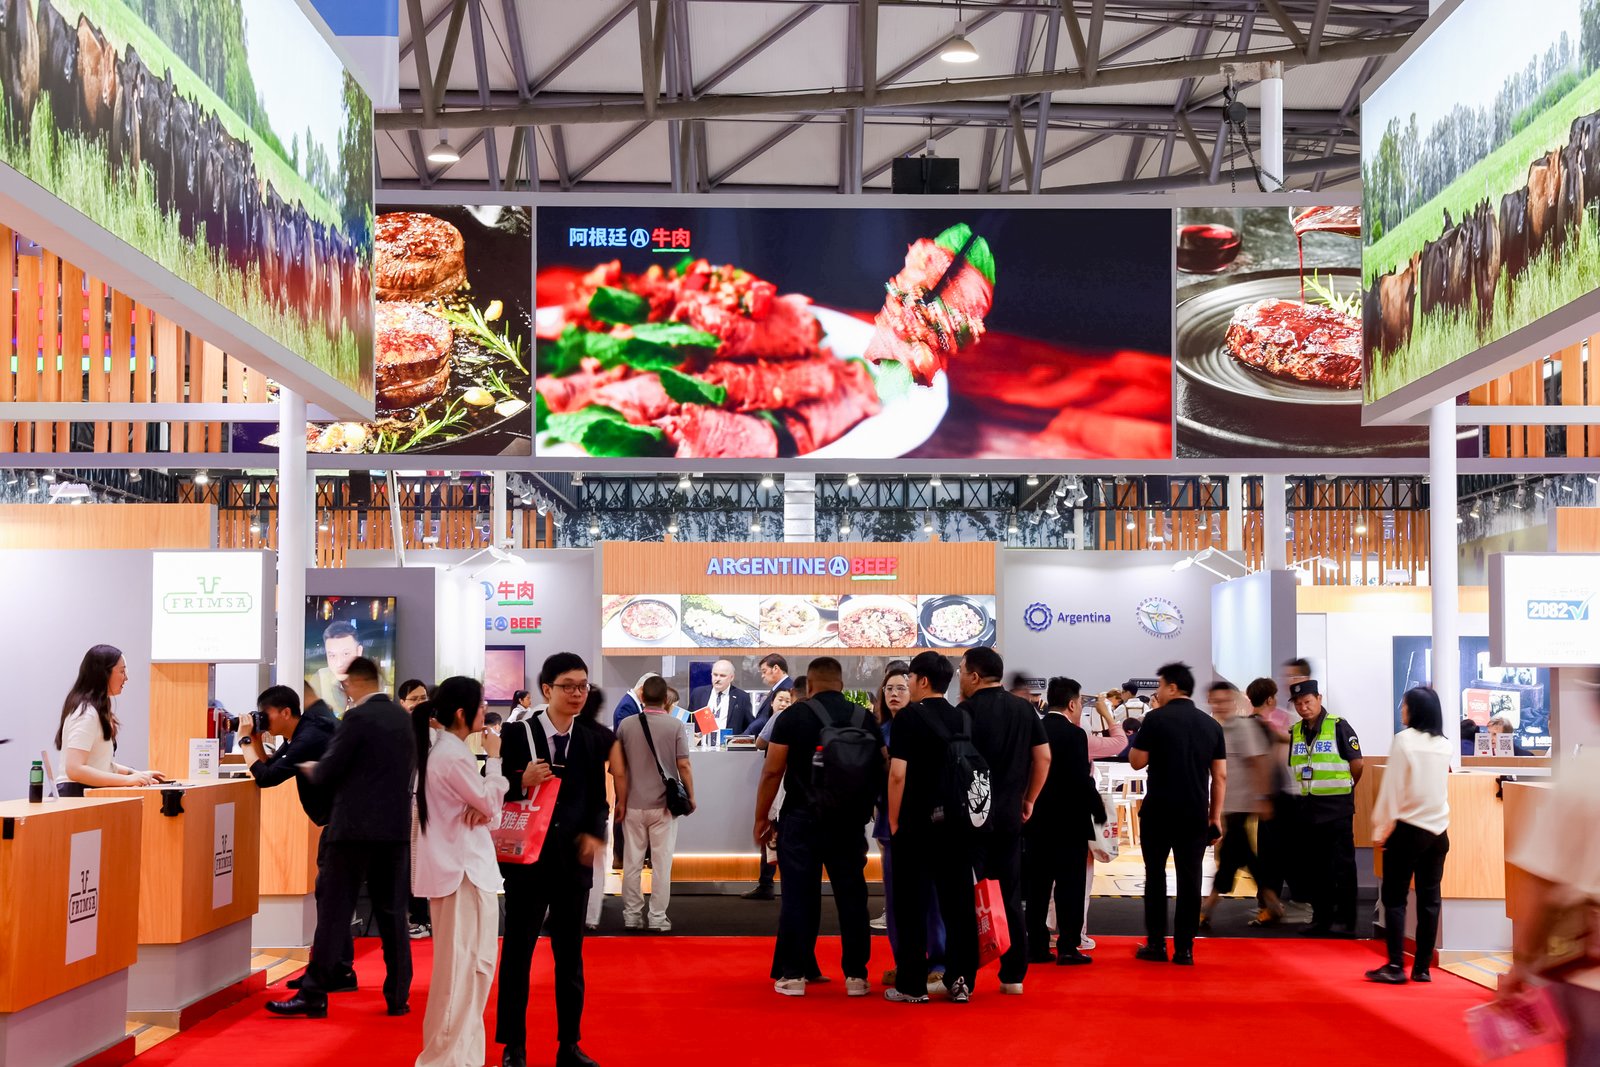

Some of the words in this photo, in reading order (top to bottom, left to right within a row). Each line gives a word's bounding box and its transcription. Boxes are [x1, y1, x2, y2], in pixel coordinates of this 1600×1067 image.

[569, 227, 627, 247] 阿根廷
[652, 228, 691, 248] 牛肉
[706, 557, 826, 576] ARGENTINE
[851, 557, 897, 575] BEEF
[497, 581, 535, 600] 牛肉
[172, 597, 246, 608] FRIMSA
[1528, 602, 1568, 618] 2082
[510, 617, 542, 629] BEEF
[1057, 611, 1111, 625] Argentina
[1315, 741, 1332, 753] 保安
[71, 895, 96, 916] FRIMSA
